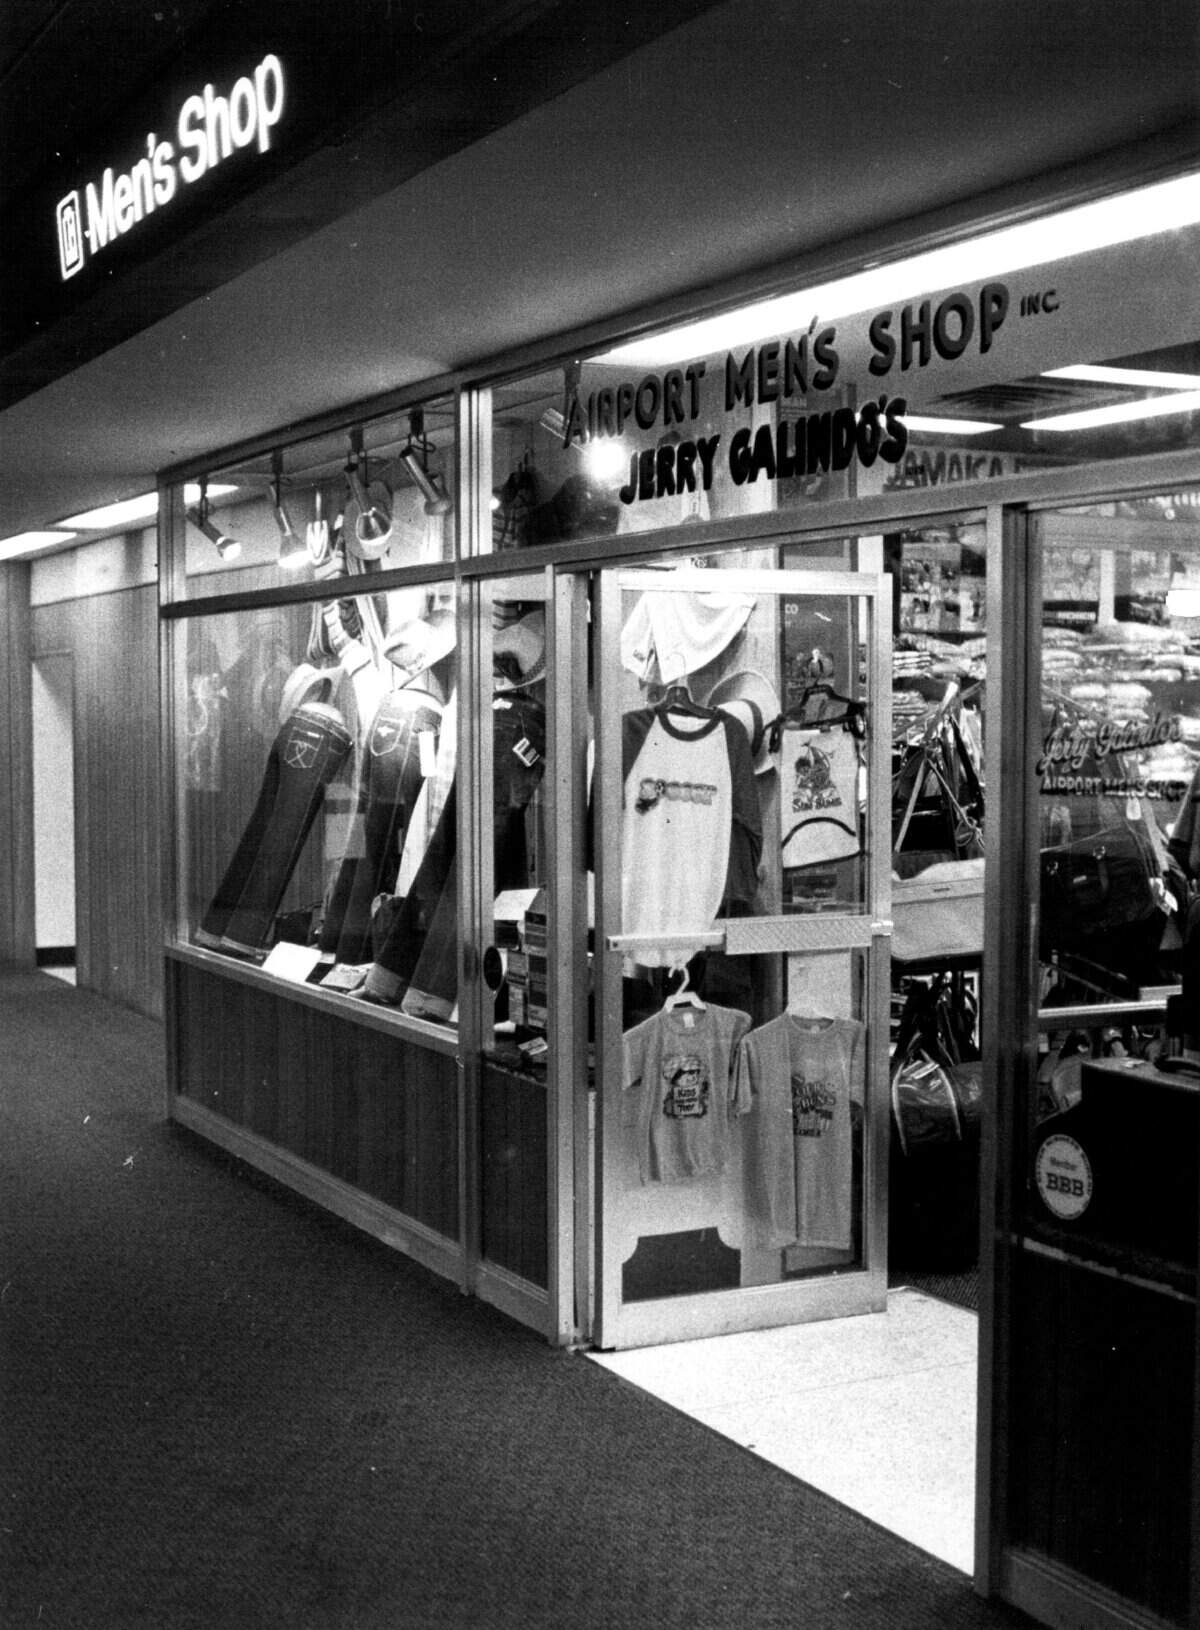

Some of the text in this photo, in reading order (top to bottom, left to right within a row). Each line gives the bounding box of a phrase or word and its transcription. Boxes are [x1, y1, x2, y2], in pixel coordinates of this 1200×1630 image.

[86, 131, 177, 255] Men's
[178, 53, 284, 184] Shop
[562, 360, 707, 449] AIRPORT
[724, 314, 840, 412] MEN'S
[868, 281, 1010, 377] SHOP
[618, 393, 908, 506] JERRY GALINDO'S
[1046, 1172, 1084, 1198] BBB
